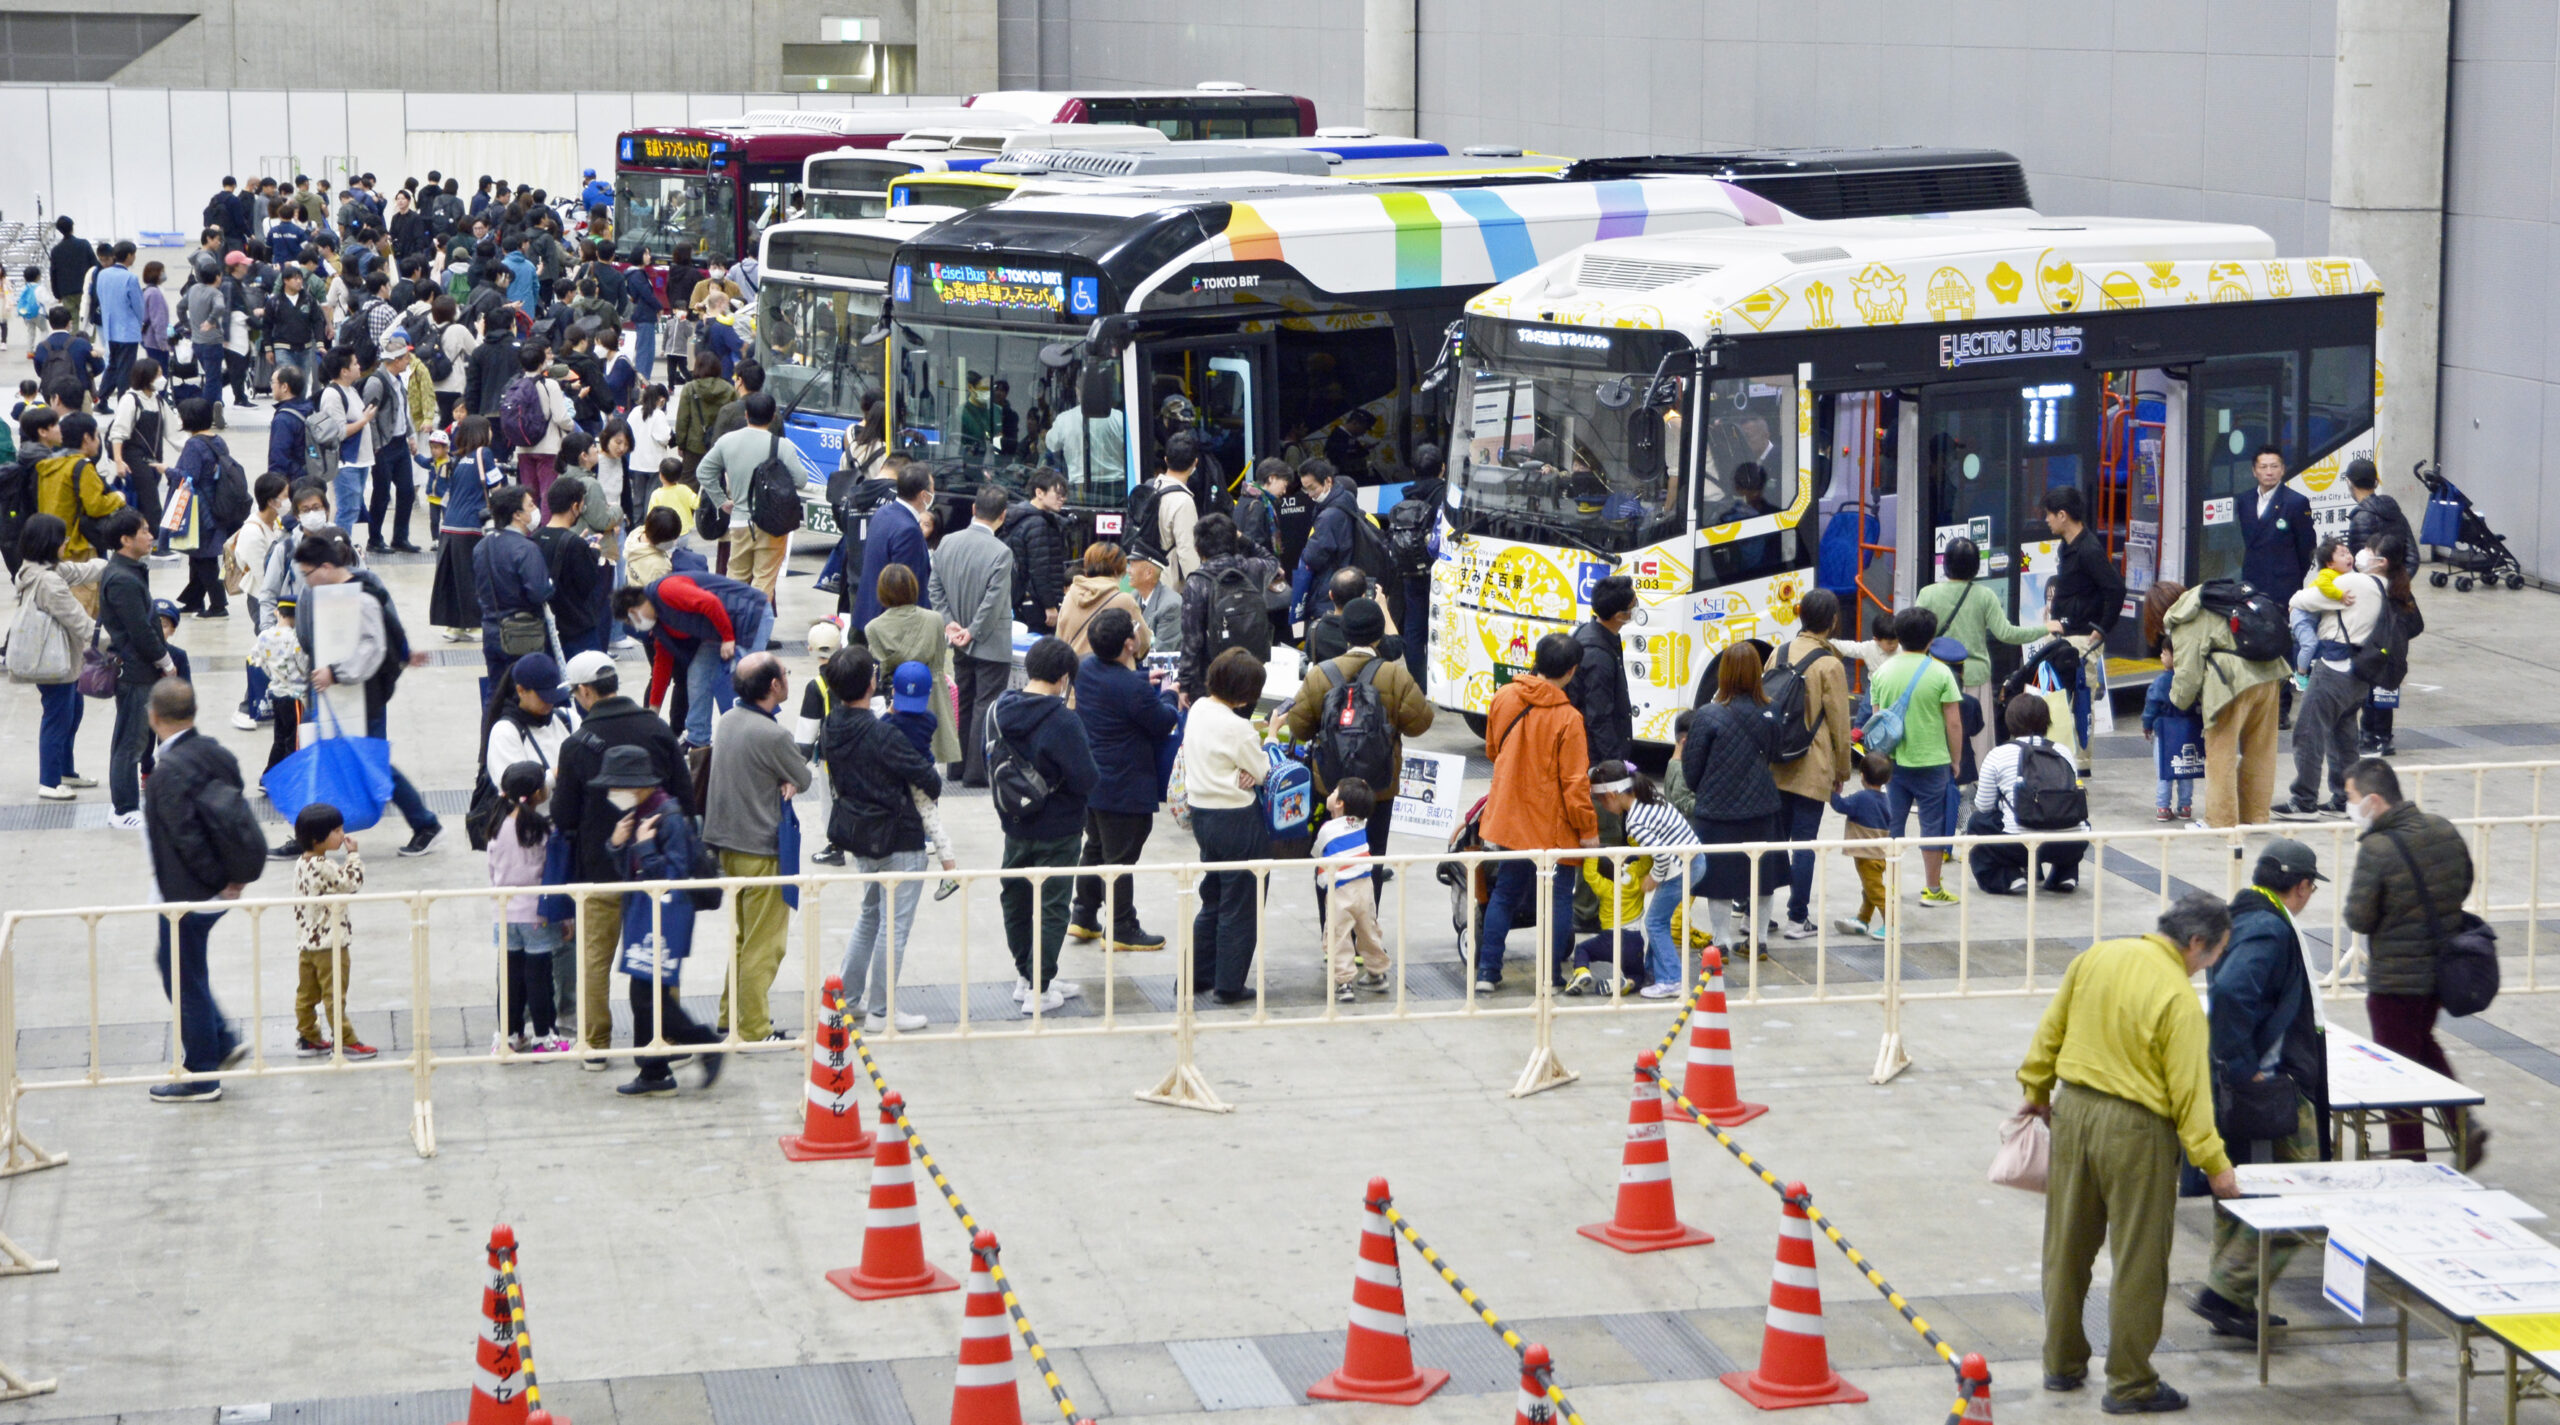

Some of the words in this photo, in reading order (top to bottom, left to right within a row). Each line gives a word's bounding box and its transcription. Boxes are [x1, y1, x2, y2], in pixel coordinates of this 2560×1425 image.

[930, 262, 964, 281] Keisei
[966, 268, 986, 282] Bus
[1006, 268, 1041, 284] TOKYO
[1042, 271, 1063, 285] BRT
[1202, 276, 1238, 290] TOKYO
[1239, 274, 1260, 287] BRT
[942, 282, 1059, 309] お客様感謝フェスティバル
[1939, 329, 2017, 367] ELECTRIC
[2021, 326, 2051, 352] BUS
[820, 434, 842, 450] 336
[2352, 449, 2373, 461] 1803
[1281, 497, 1296, 507] 入口
[2216, 501, 2232, 512] 出口
[1280, 506, 1305, 516] ENTRANCE
[1460, 566, 1524, 590] すみだ百景
[1459, 584, 1511, 601] すみりんちゃん
